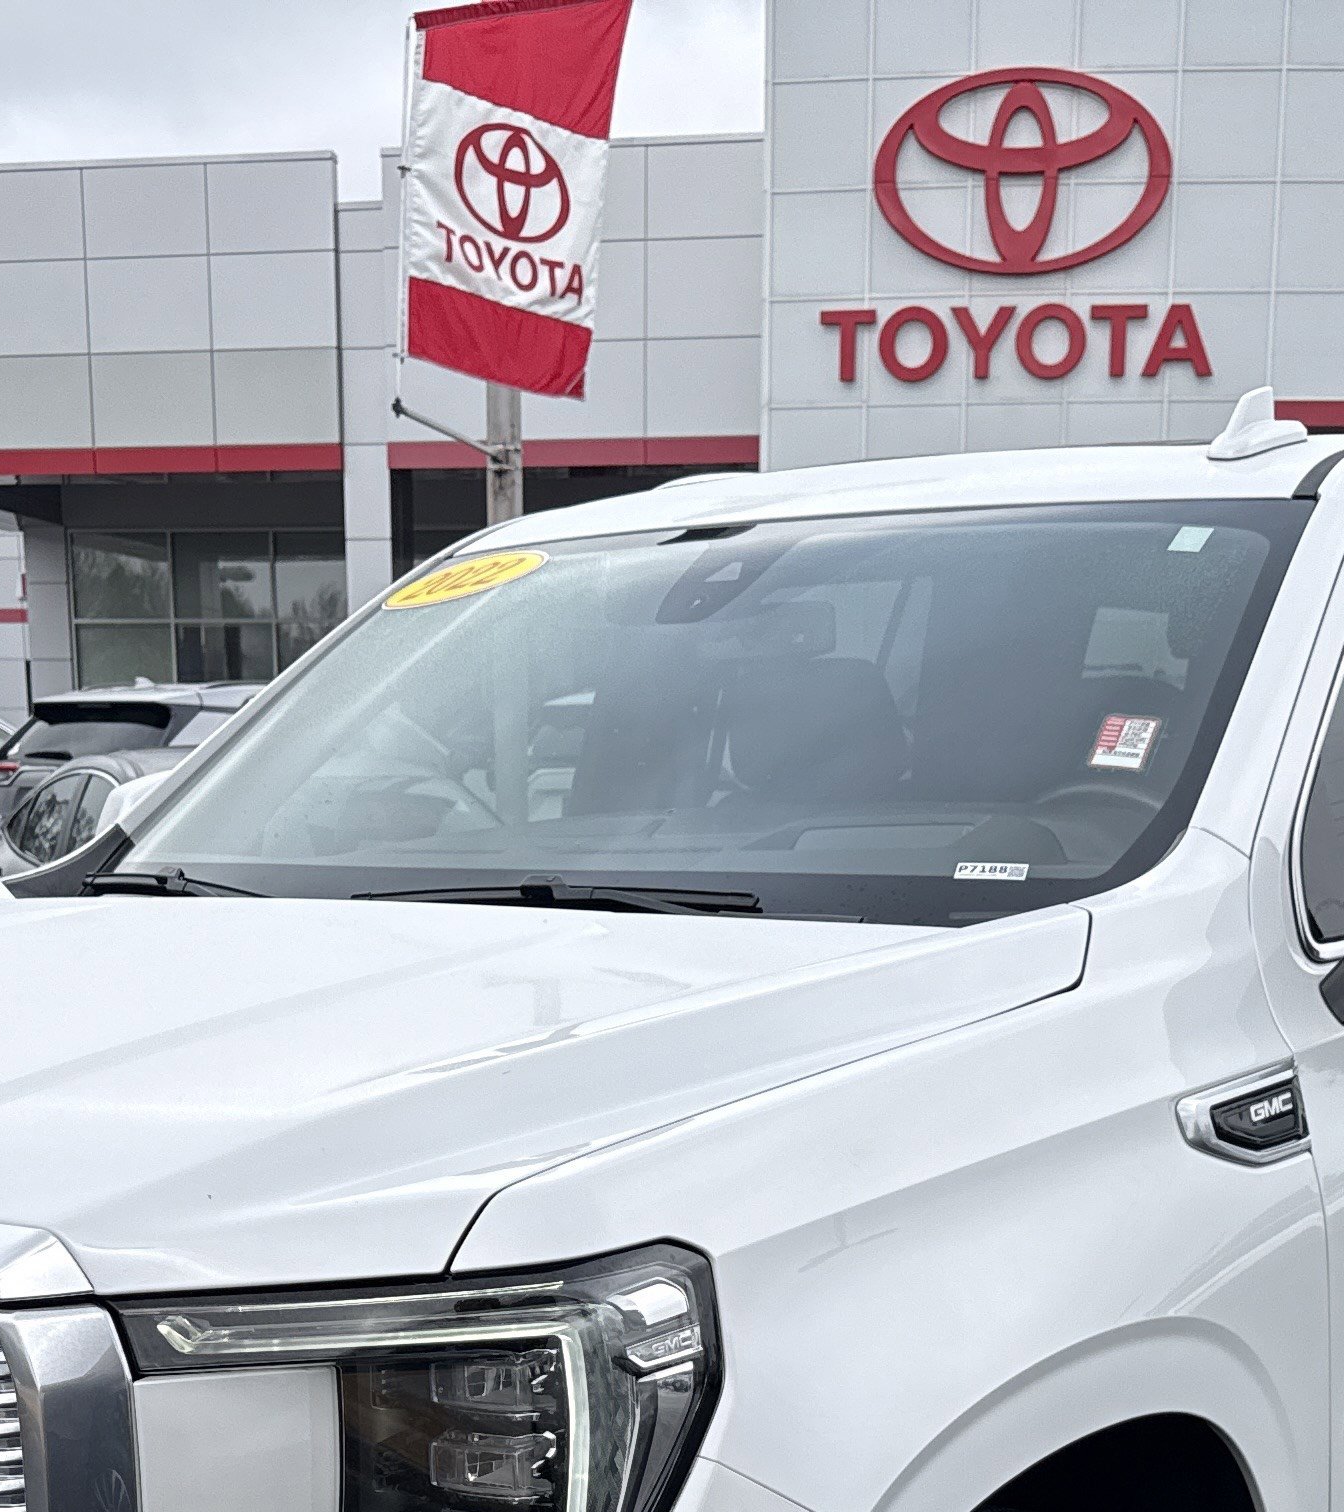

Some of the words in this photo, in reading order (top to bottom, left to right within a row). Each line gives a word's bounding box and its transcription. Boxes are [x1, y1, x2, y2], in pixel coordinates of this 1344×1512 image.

[436, 220, 584, 306] TOYOTA
[820, 302, 1213, 383] TOYOTA
[397, 558, 527, 602] 2022
[1250, 1092, 1293, 1122] GMC
